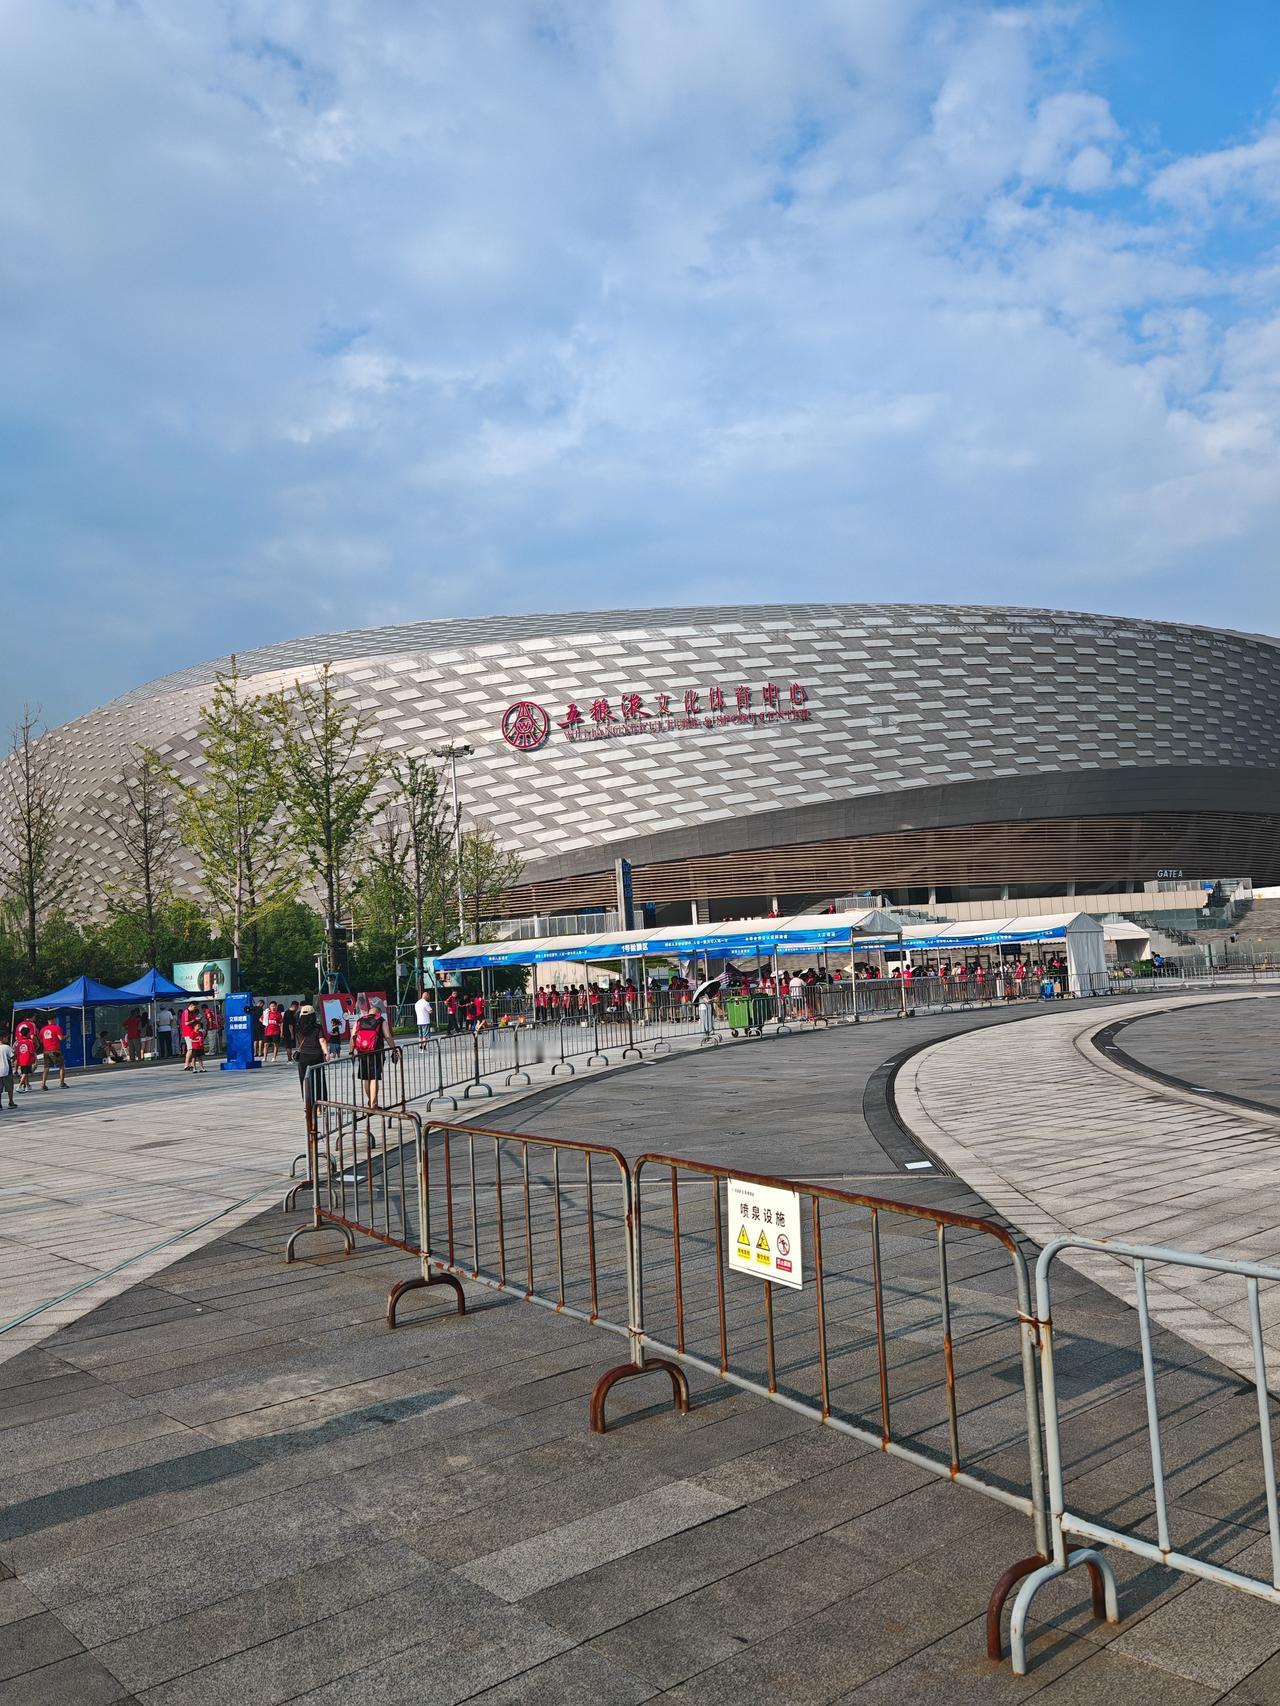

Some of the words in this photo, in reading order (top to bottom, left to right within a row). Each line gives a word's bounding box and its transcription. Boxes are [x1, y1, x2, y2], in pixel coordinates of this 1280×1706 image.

[557, 682, 808, 728] 五粮液文化体育中心
[1157, 869, 1177, 878] GATE
[1178, 869, 1183, 878] A
[740, 1203, 786, 1227] 喷泉设施
